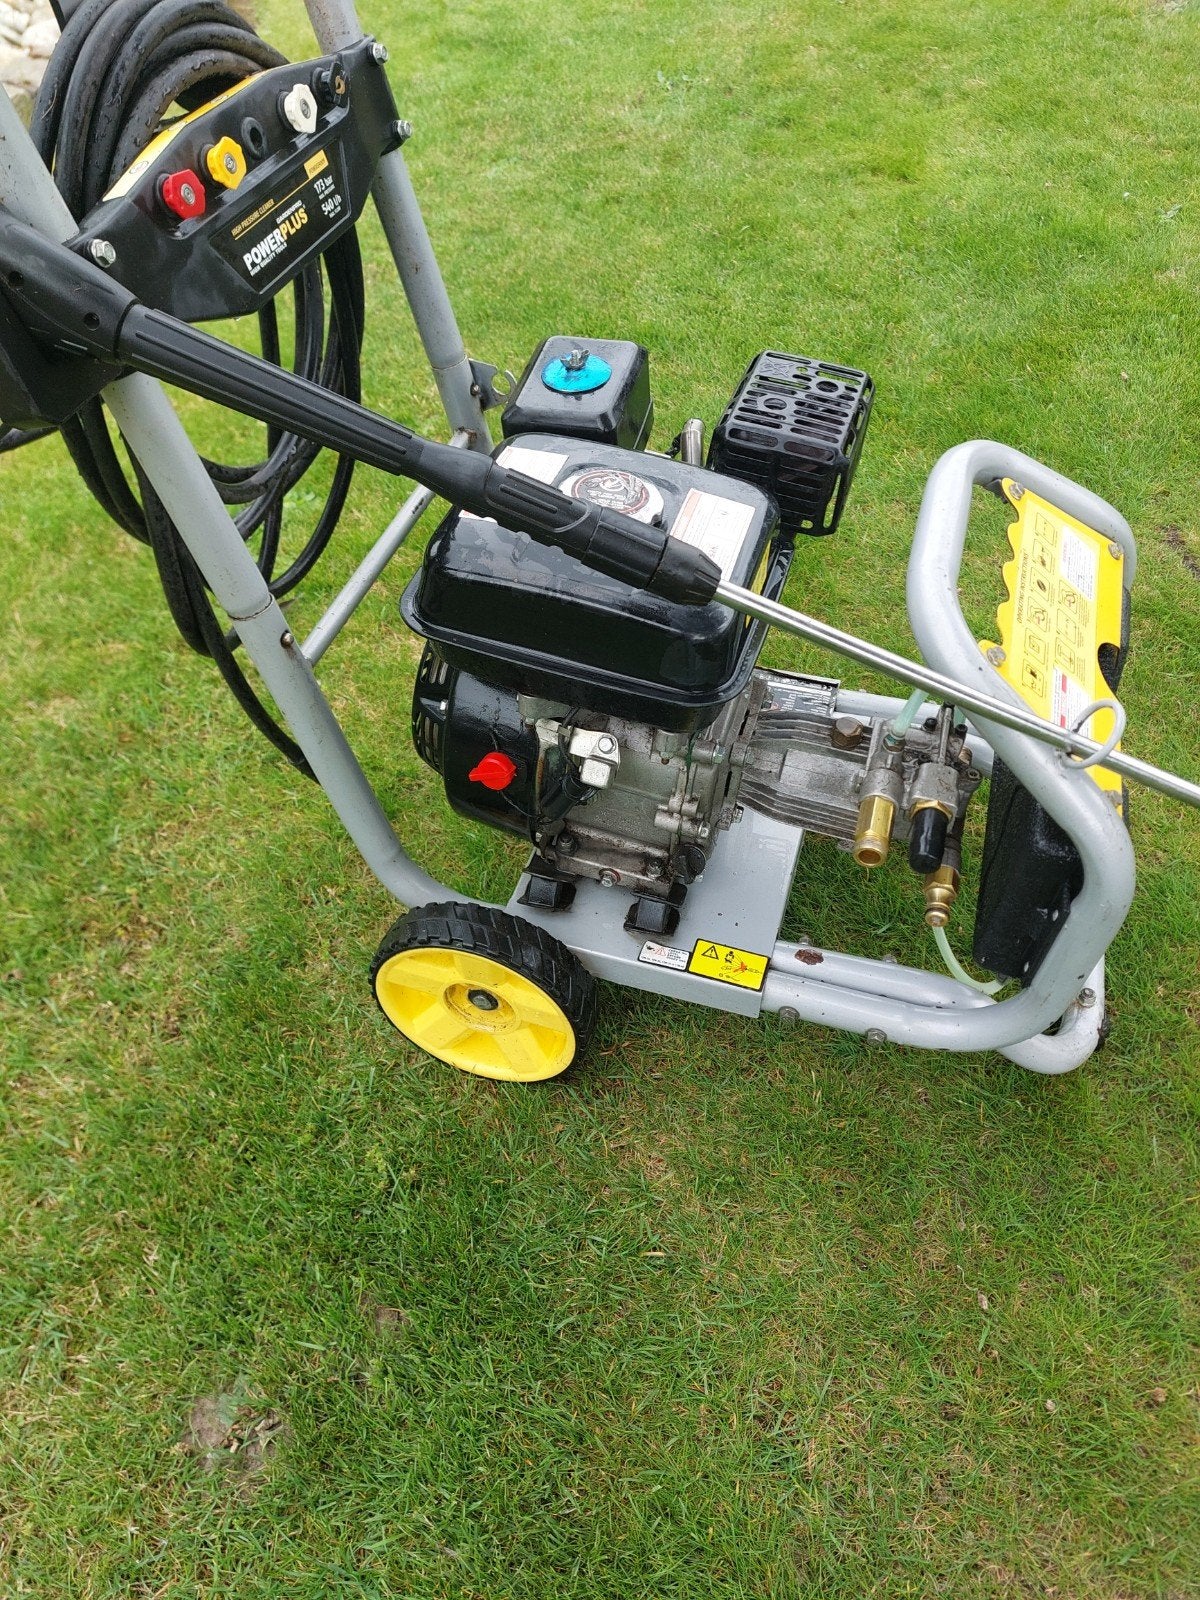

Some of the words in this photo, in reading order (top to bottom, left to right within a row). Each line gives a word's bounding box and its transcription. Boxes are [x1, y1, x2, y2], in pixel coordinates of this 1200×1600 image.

[313, 179, 326, 195] 173
[323, 175, 334, 187] bar
[321, 198, 335, 216] 540
